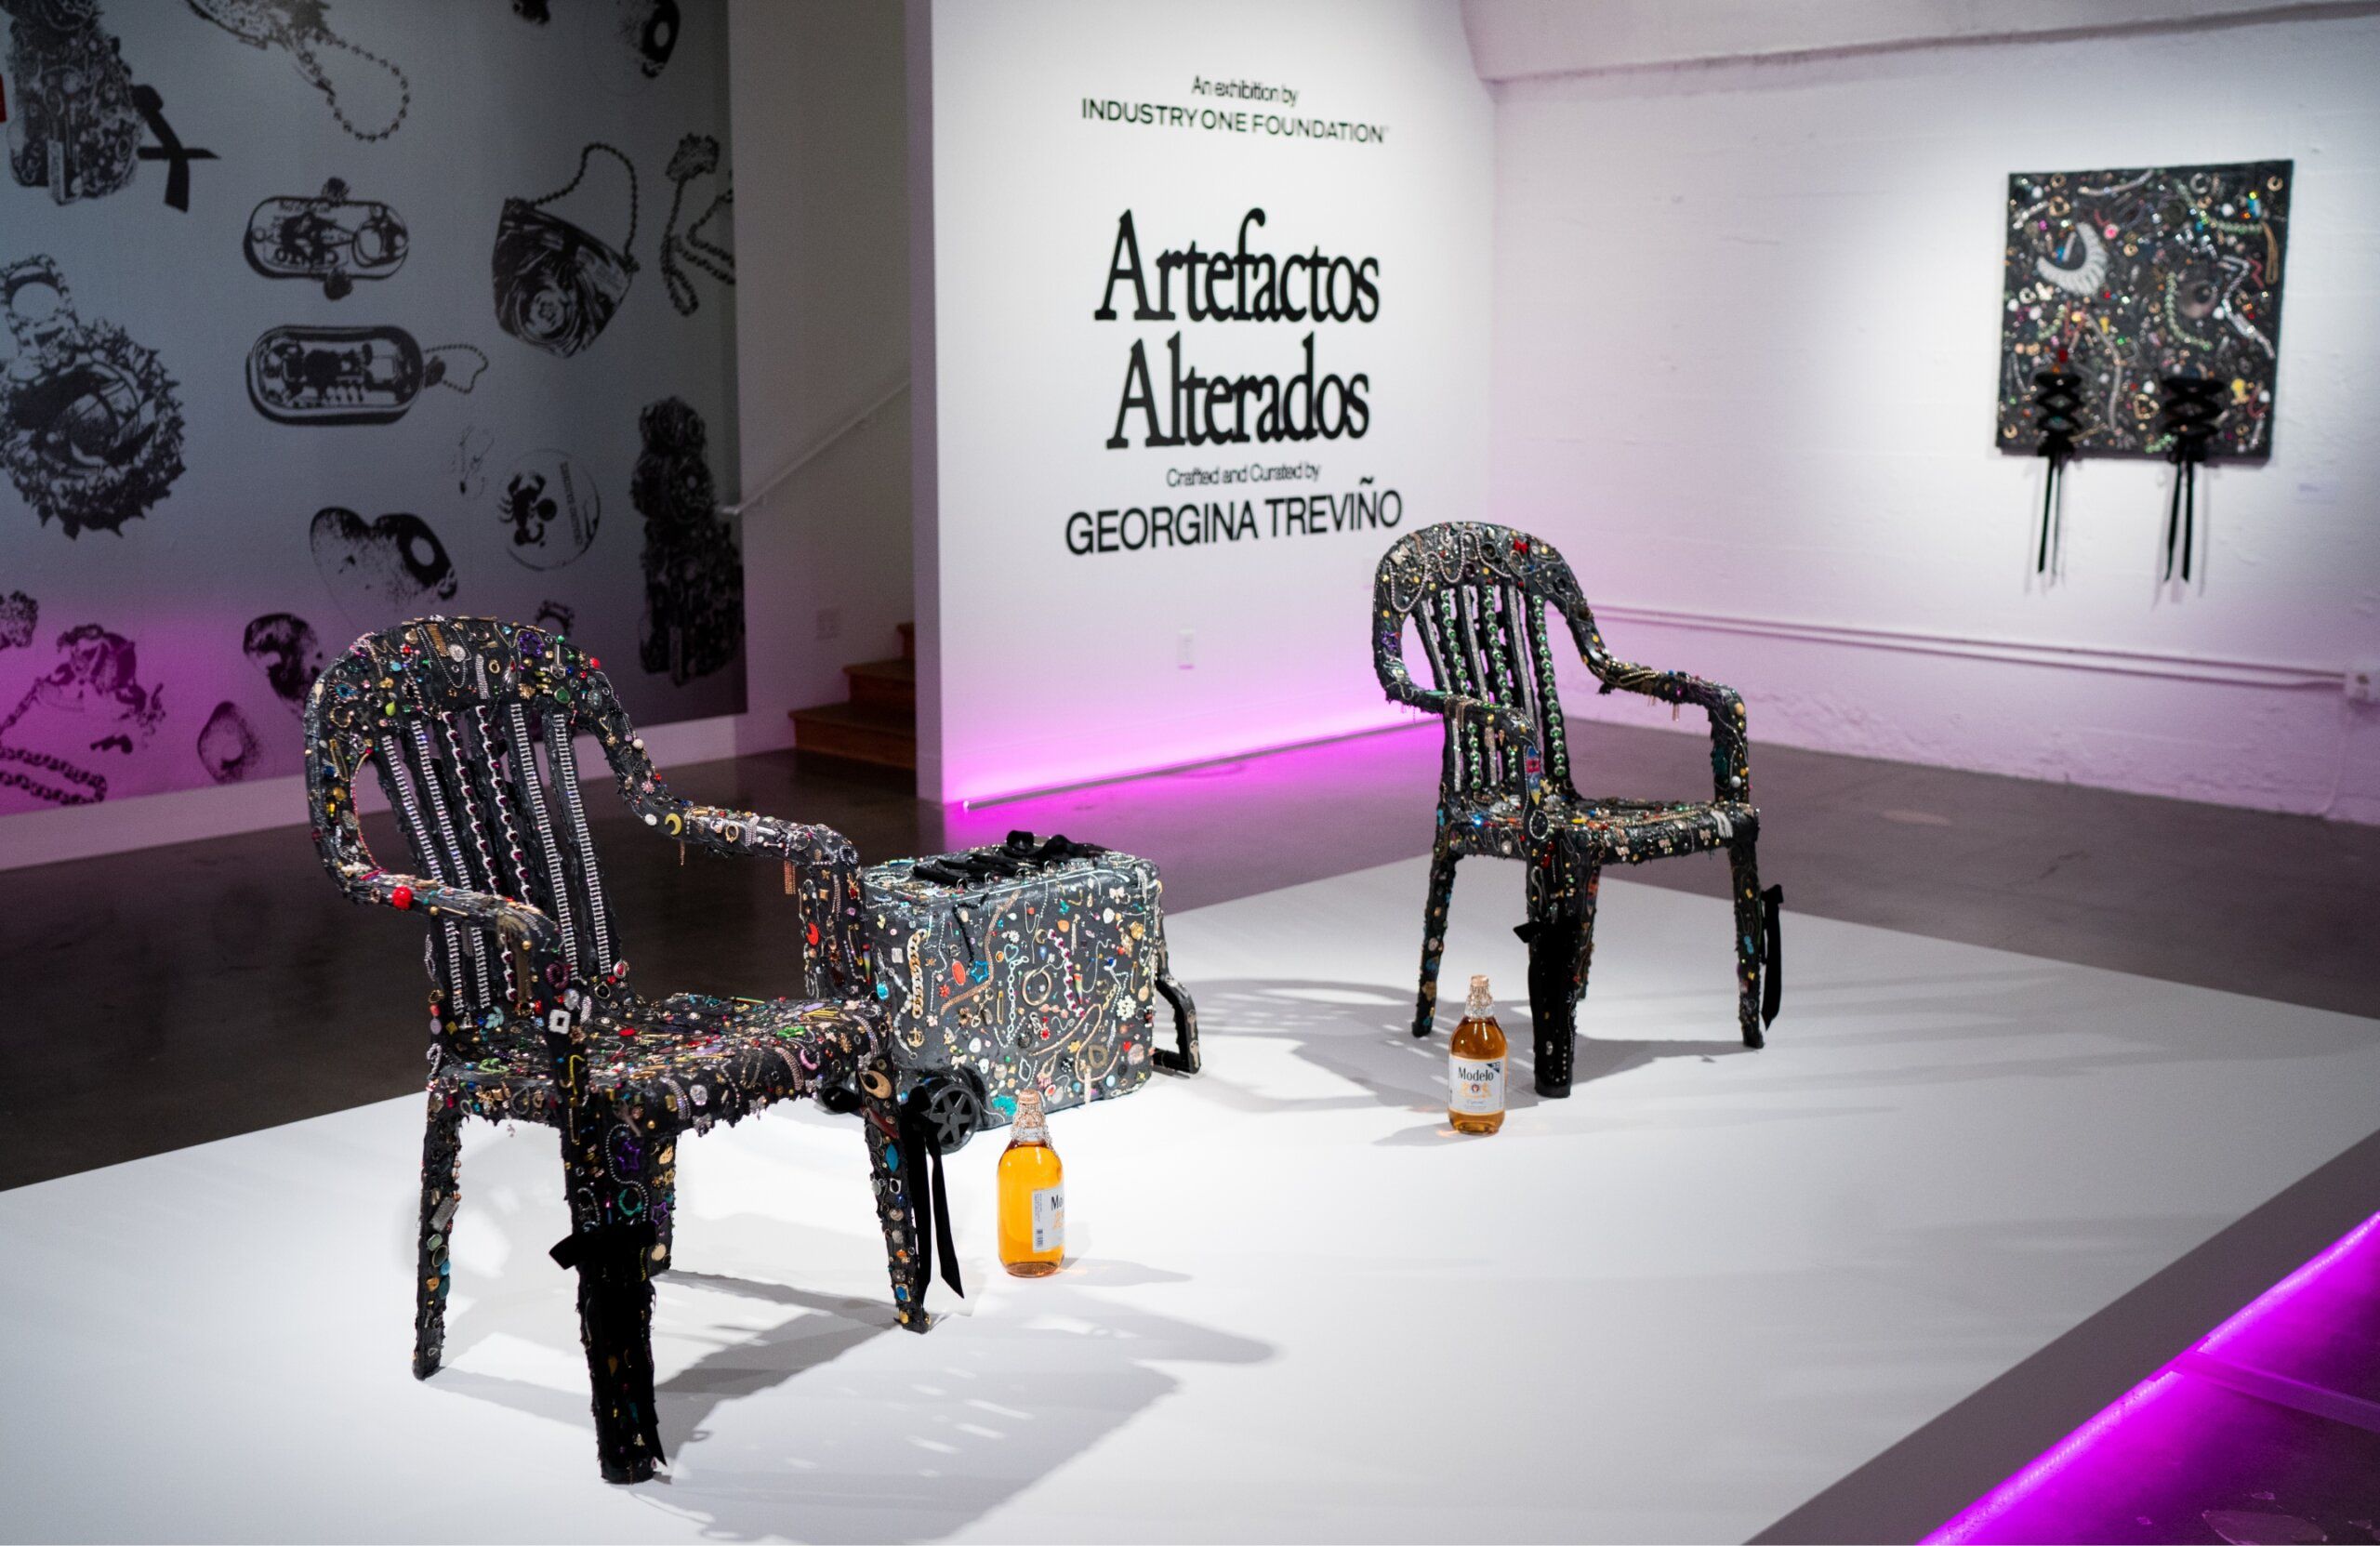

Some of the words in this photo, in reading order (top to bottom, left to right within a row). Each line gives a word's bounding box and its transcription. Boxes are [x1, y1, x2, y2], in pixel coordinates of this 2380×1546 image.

[1191, 75, 1210, 95] An
[1214, 78, 1279, 101] exhibition
[1281, 85, 1298, 107] by
[1082, 99, 1197, 127] INDUSTRY
[1201, 109, 1247, 132] ONE
[1094, 207, 1380, 323] Artefactos
[1106, 331, 1369, 449] Alterados
[1167, 467, 1219, 487] Crafted
[1223, 466, 1247, 483] and
[1250, 463, 1302, 482] Curated
[1304, 461, 1320, 482] by
[1065, 499, 1258, 555] GEORGINA
[1264, 477, 1402, 538] TREVIÑO
[1458, 1066, 1493, 1081] Modelo
